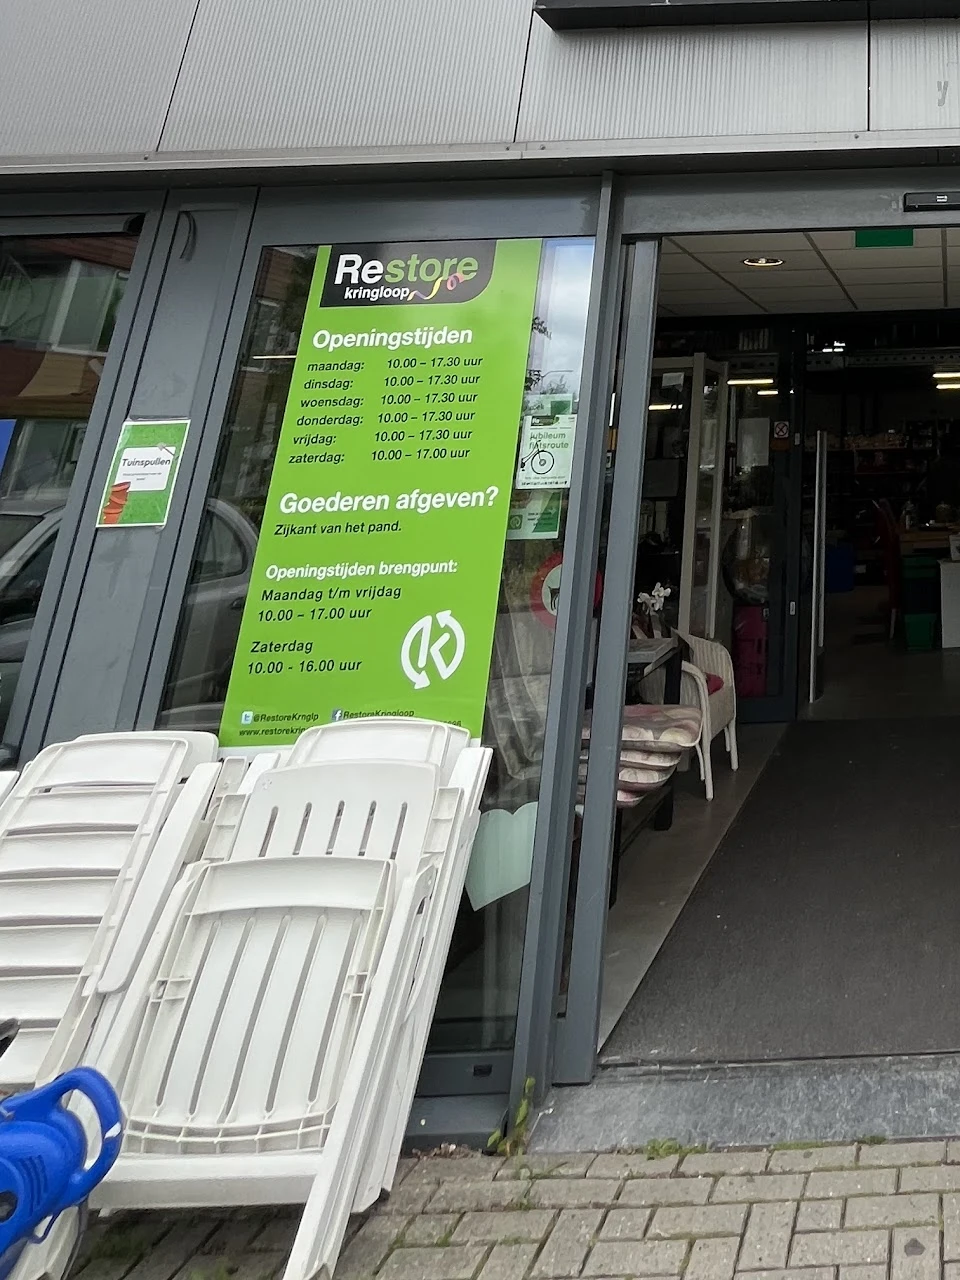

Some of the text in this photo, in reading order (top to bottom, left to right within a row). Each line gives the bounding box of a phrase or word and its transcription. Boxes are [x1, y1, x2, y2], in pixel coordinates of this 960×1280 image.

[334, 254, 478, 285] Restore
[344, 286, 410, 301] kringloop
[313, 326, 473, 352] Openingstijden
[308, 360, 365, 372] maandag:
[387, 359, 417, 369] 10.00
[431, 357, 460, 367] 17.30
[464, 357, 483, 366] uur
[304, 379, 353, 391] dinsdag:
[384, 377, 414, 387] 10.00
[428, 375, 458, 385] 17.30
[461, 375, 480, 384] uur
[300, 397, 364, 408] woensdag:
[381, 395, 411, 405] 10.00
[425, 393, 455, 403] 17.30
[458, 393, 478, 402] uur
[297, 415, 363, 427] donderdag:
[378, 413, 408, 423] 10.00
[422, 411, 452, 421] 17.30
[456, 411, 475, 420] uur
[293, 433, 336, 446] vrijdag:
[375, 431, 405, 442] 10.00
[419, 429, 449, 440] 17.30
[453, 430, 472, 439] uur
[122, 458, 170, 467] Tuinspullen
[288, 452, 345, 464] zaterdag:
[371, 450, 402, 461] 10.00
[417, 449, 447, 459] 17.00
[450, 449, 470, 458] uur
[280, 486, 499, 514] Goederen afgeven?
[274, 521, 402, 537] Zijkant van het pand.
[266, 559, 458, 581] Openingstijden brengpunt:
[261, 585, 401, 602] Maandag t/m vrijdag
[258, 609, 293, 622] 10.00
[310, 608, 344, 620] 17.00
[349, 608, 372, 618] uur
[250, 640, 313, 654] Zaterdag
[248, 661, 283, 674] 10.00
[299, 659, 334, 672] 16.00
[339, 660, 362, 671] uur
[254, 713, 319, 722] @RestoreKrnglp
